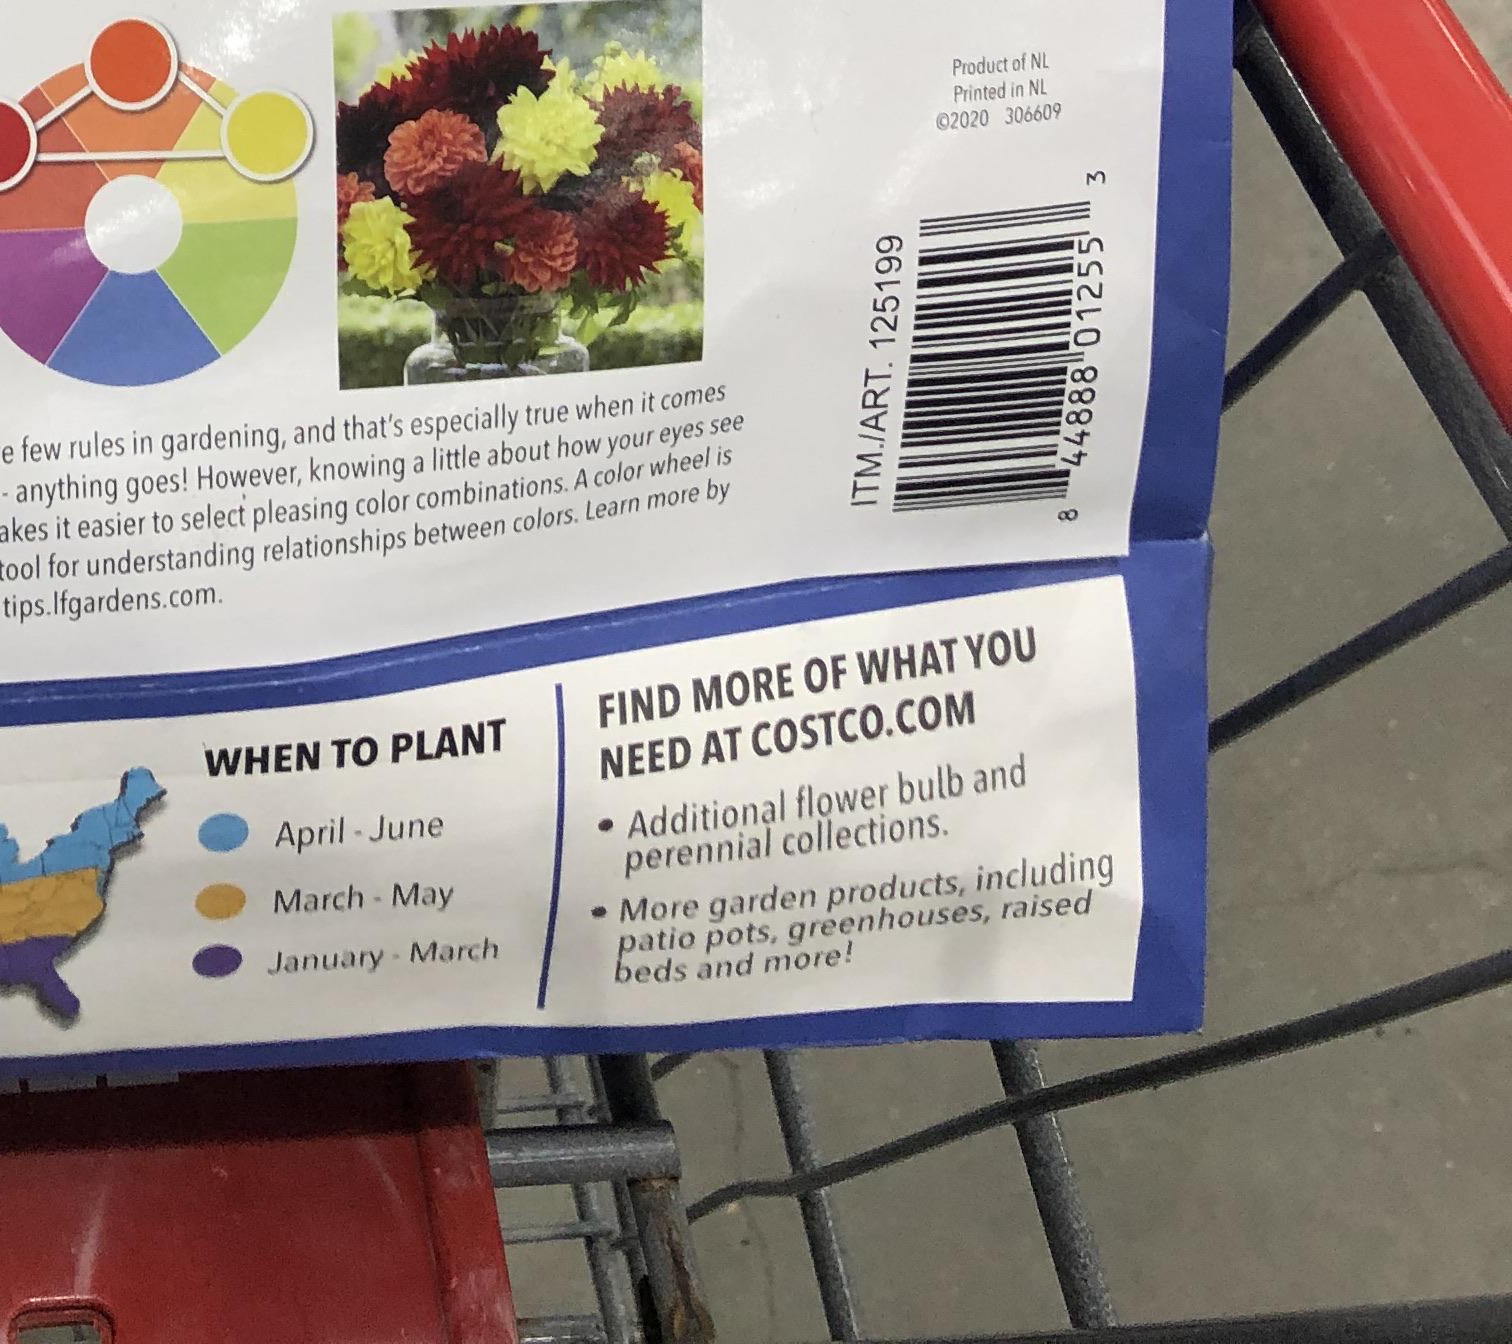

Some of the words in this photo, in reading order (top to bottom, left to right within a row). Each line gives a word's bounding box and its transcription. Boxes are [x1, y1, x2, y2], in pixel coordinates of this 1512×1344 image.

[936, 108, 990, 131] ©2020
[1004, 102, 1062, 125] 306609
[1086, 170, 1106, 185] 3
[869, 234, 904, 349] 125199
[1072, 237, 1105, 347] 01255
[851, 361, 894, 506] ITM./ART.
[1060, 366, 1099, 467] 44888
[1057, 508, 1078, 521] 8
[4, 586, 222, 624] tips.lfgardens.com.
[598, 683, 681, 728] FIND
[692, 662, 794, 713] MORE
[804, 654, 847, 694] OF
[856, 638, 958, 685] WHAT
[963, 626, 1036, 670] YOU
[204, 740, 320, 777] WHEN
[330, 736, 379, 769] TO
[391, 718, 506, 764] PLANT
[600, 736, 692, 781] NEED
[702, 726, 742, 766] AT
[751, 690, 976, 757] COSTCO.COM
